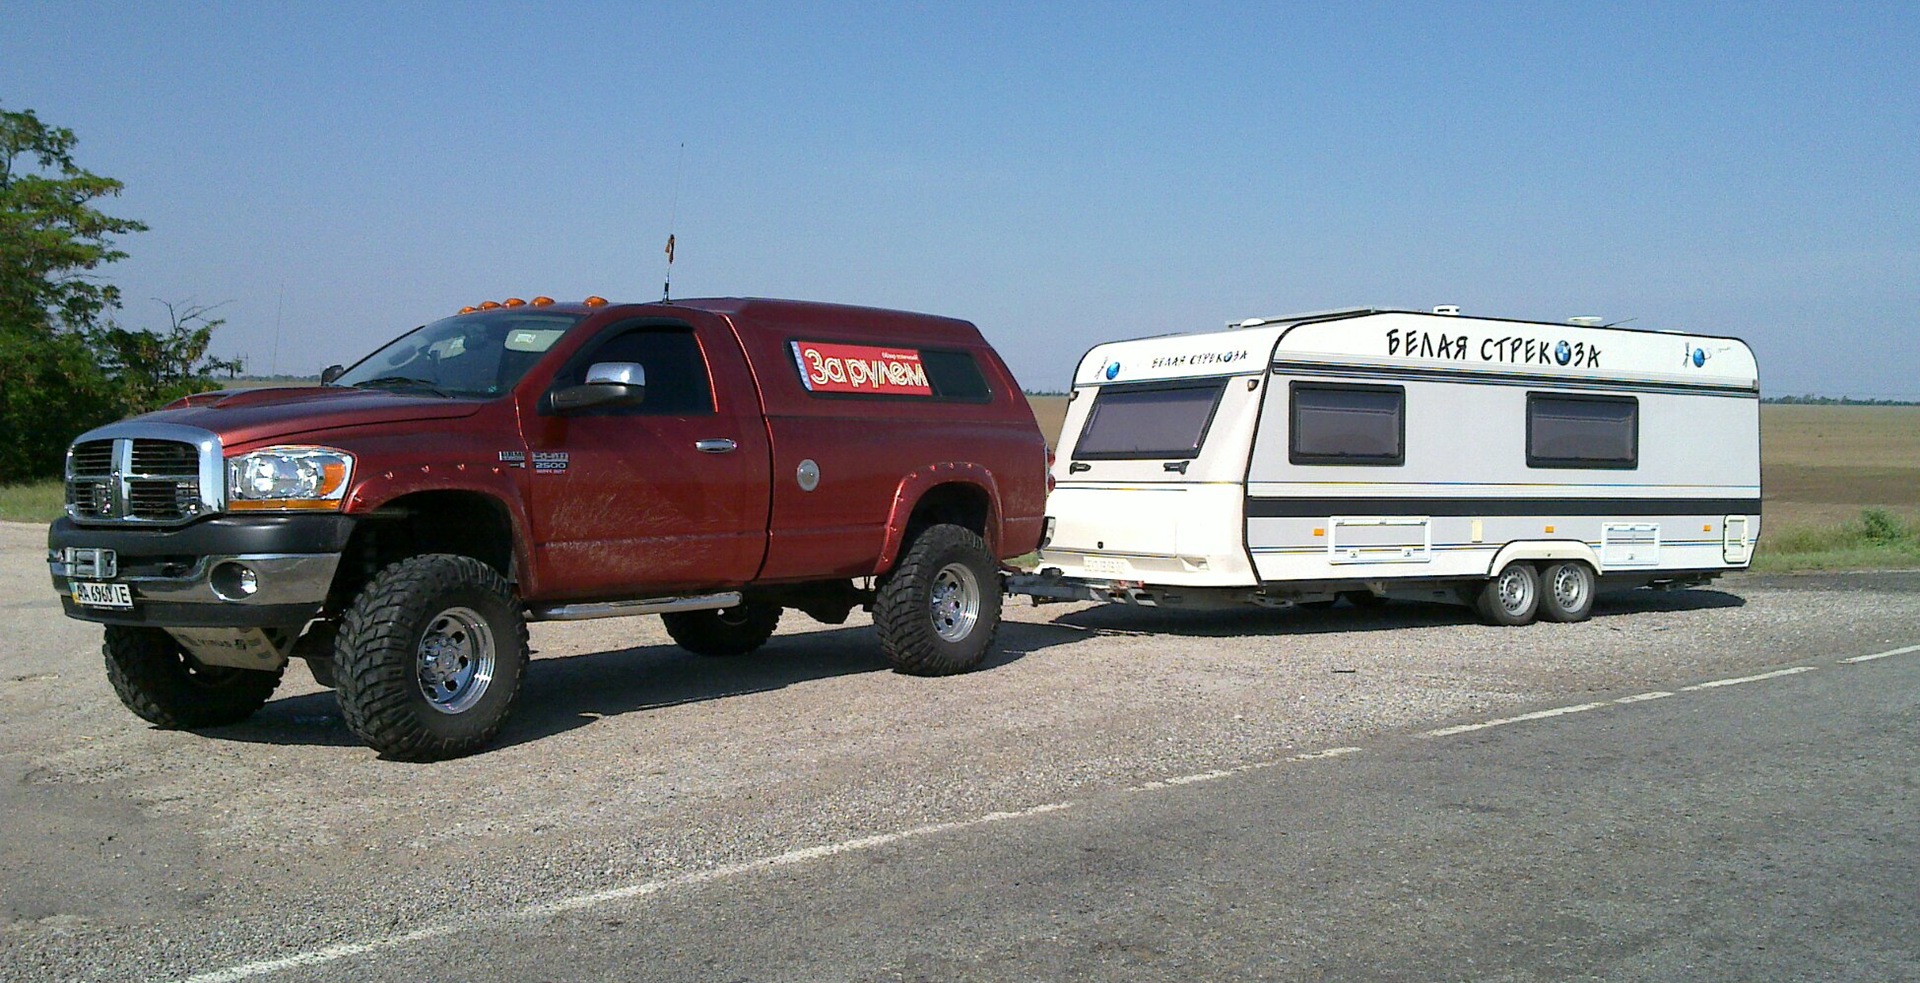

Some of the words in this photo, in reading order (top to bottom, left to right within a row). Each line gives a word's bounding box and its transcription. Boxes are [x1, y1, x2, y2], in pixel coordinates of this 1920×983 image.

[1386, 328, 1468, 361] БЕЛАЯ
[1480, 336, 1602, 368] СТРЕКОЗА
[804, 349, 847, 385] За
[845, 358, 930, 389] рулем
[114, 586, 130, 604] IE
